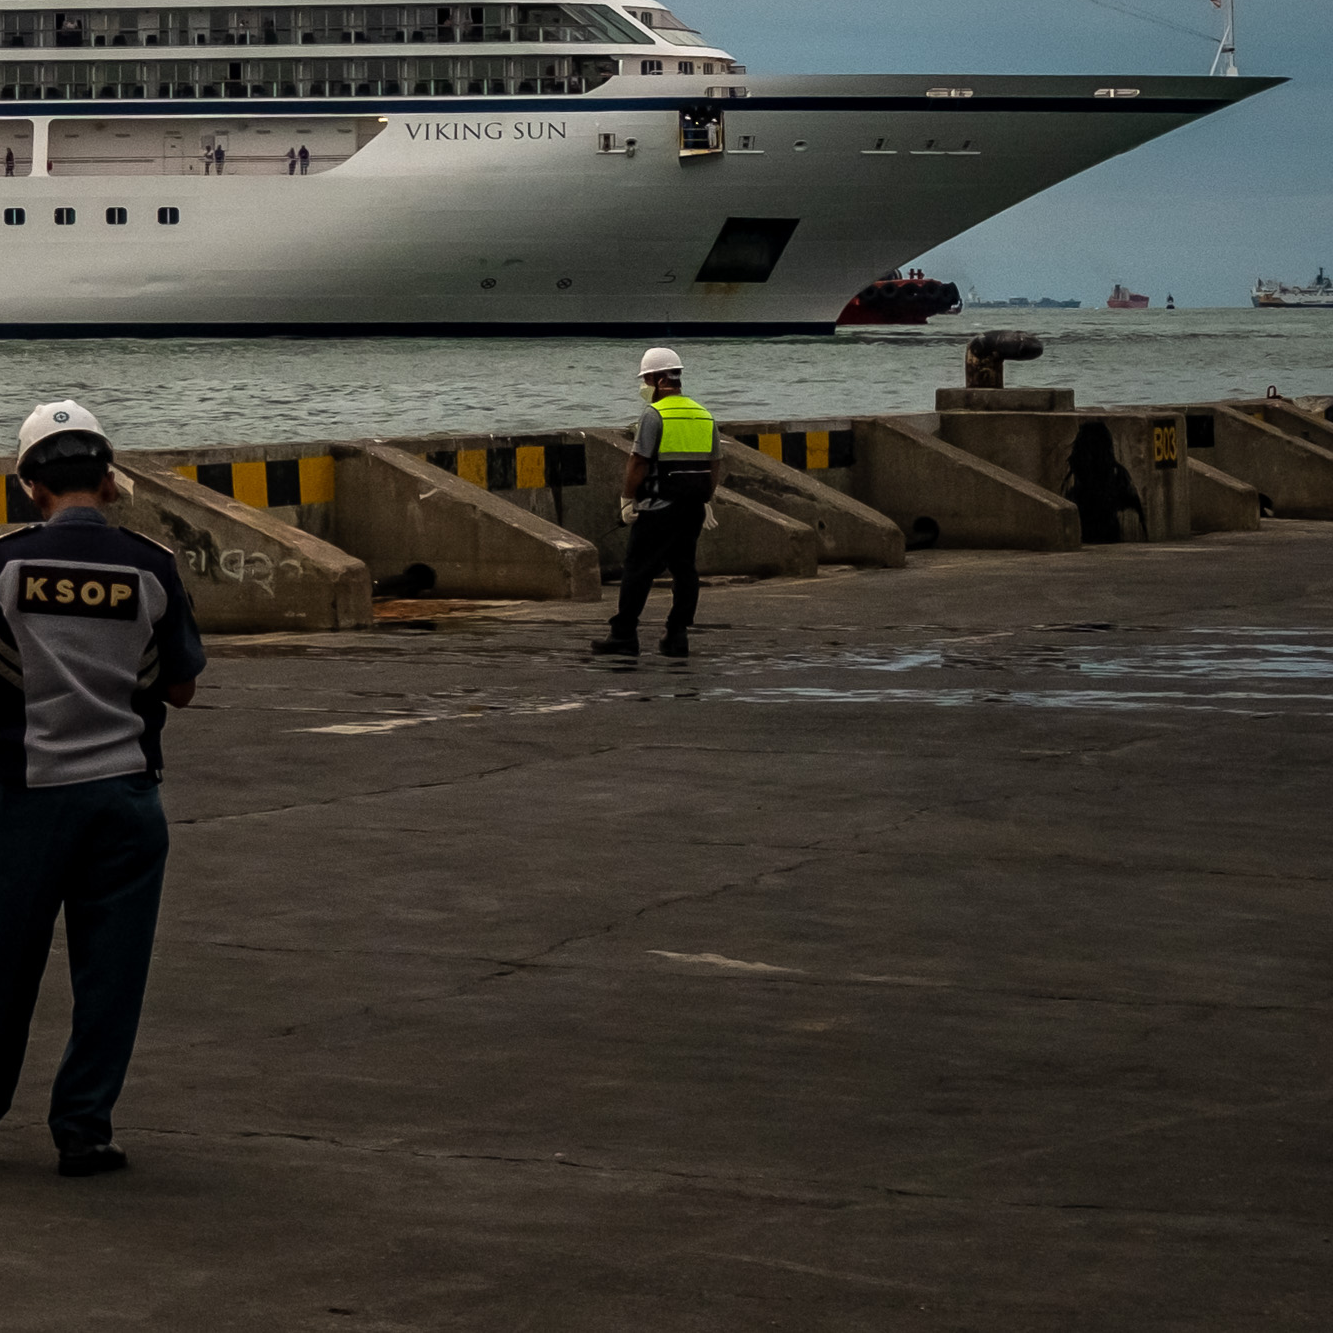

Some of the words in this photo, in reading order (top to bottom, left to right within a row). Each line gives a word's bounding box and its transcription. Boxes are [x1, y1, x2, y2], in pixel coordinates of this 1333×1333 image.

[405, 122, 503, 141] VIKING
[513, 121, 567, 140] SUN
[1153, 427, 1178, 462] B03
[25, 576, 133, 608] KSOP
